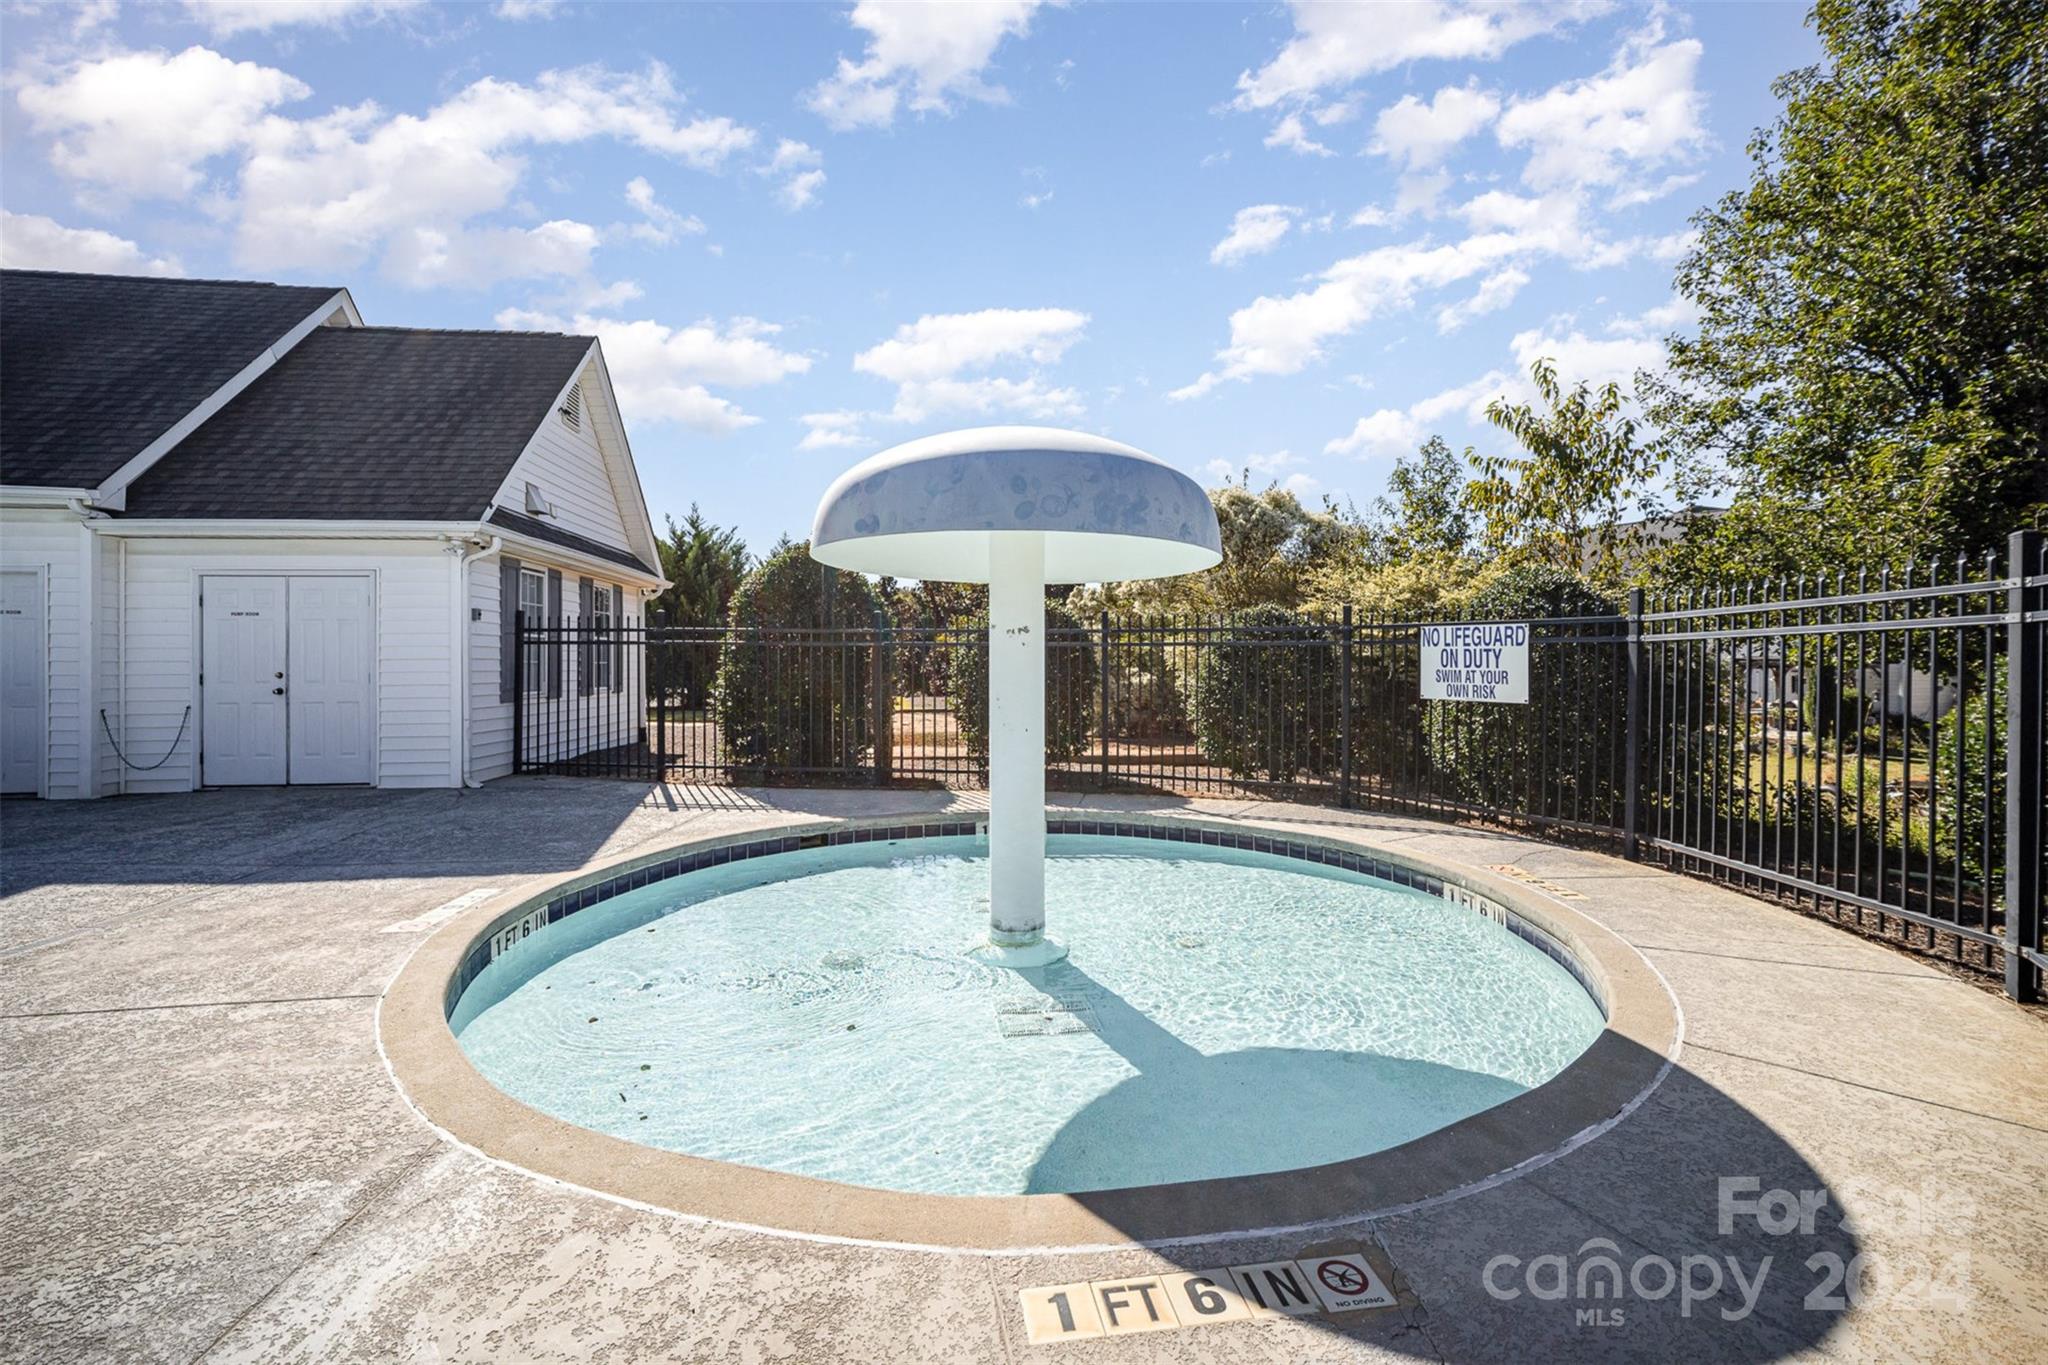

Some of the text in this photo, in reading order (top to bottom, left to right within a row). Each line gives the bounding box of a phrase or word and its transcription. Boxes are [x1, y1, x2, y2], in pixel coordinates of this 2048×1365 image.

[1422, 625, 1526, 647] NO LIFEGUARD
[1440, 648, 1502, 669] ON DUTY
[1435, 669, 1509, 685] SWIM AT YOUR
[1446, 683, 1496, 699] OWN RISK
[1449, 888, 1454, 902] 1
[1462, 892, 1474, 910] FT
[1480, 901, 1487, 916] 6
[496, 909, 546, 956] 1 FT 6 IN
[1047, 1268, 1310, 1333] 1 FT 6 IN
[1335, 1296, 1385, 1308] NO DIVING
